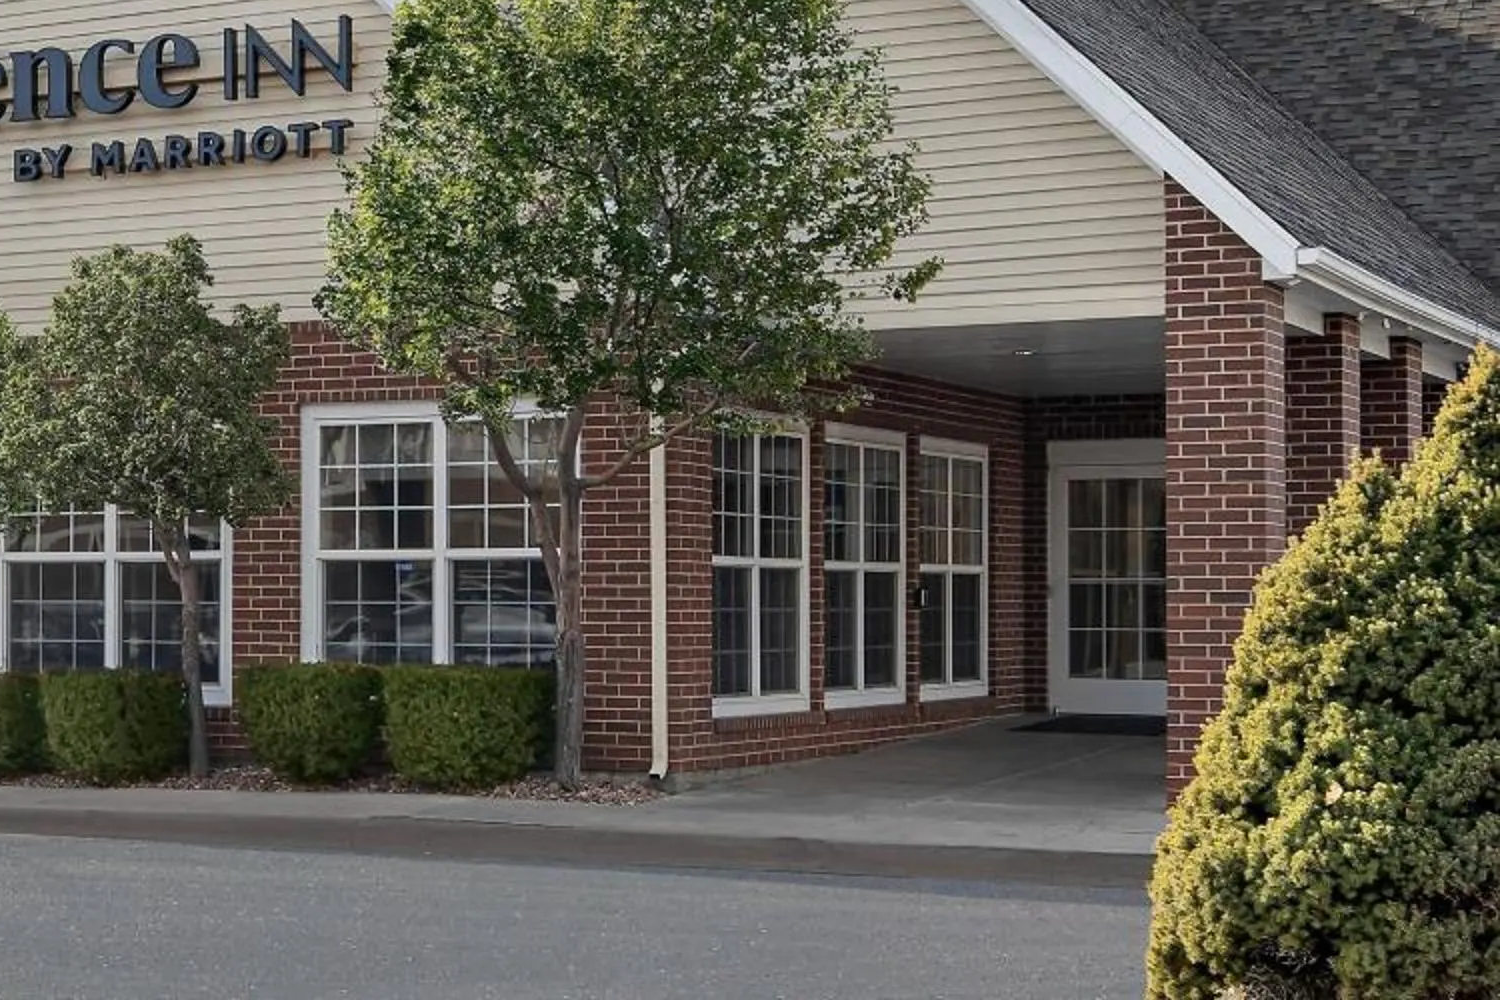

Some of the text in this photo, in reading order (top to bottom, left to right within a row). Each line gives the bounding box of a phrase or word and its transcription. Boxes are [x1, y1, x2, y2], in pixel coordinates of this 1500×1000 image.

[223, 14, 353, 100] INN
[13, 119, 355, 183] BY MARRIOTT
